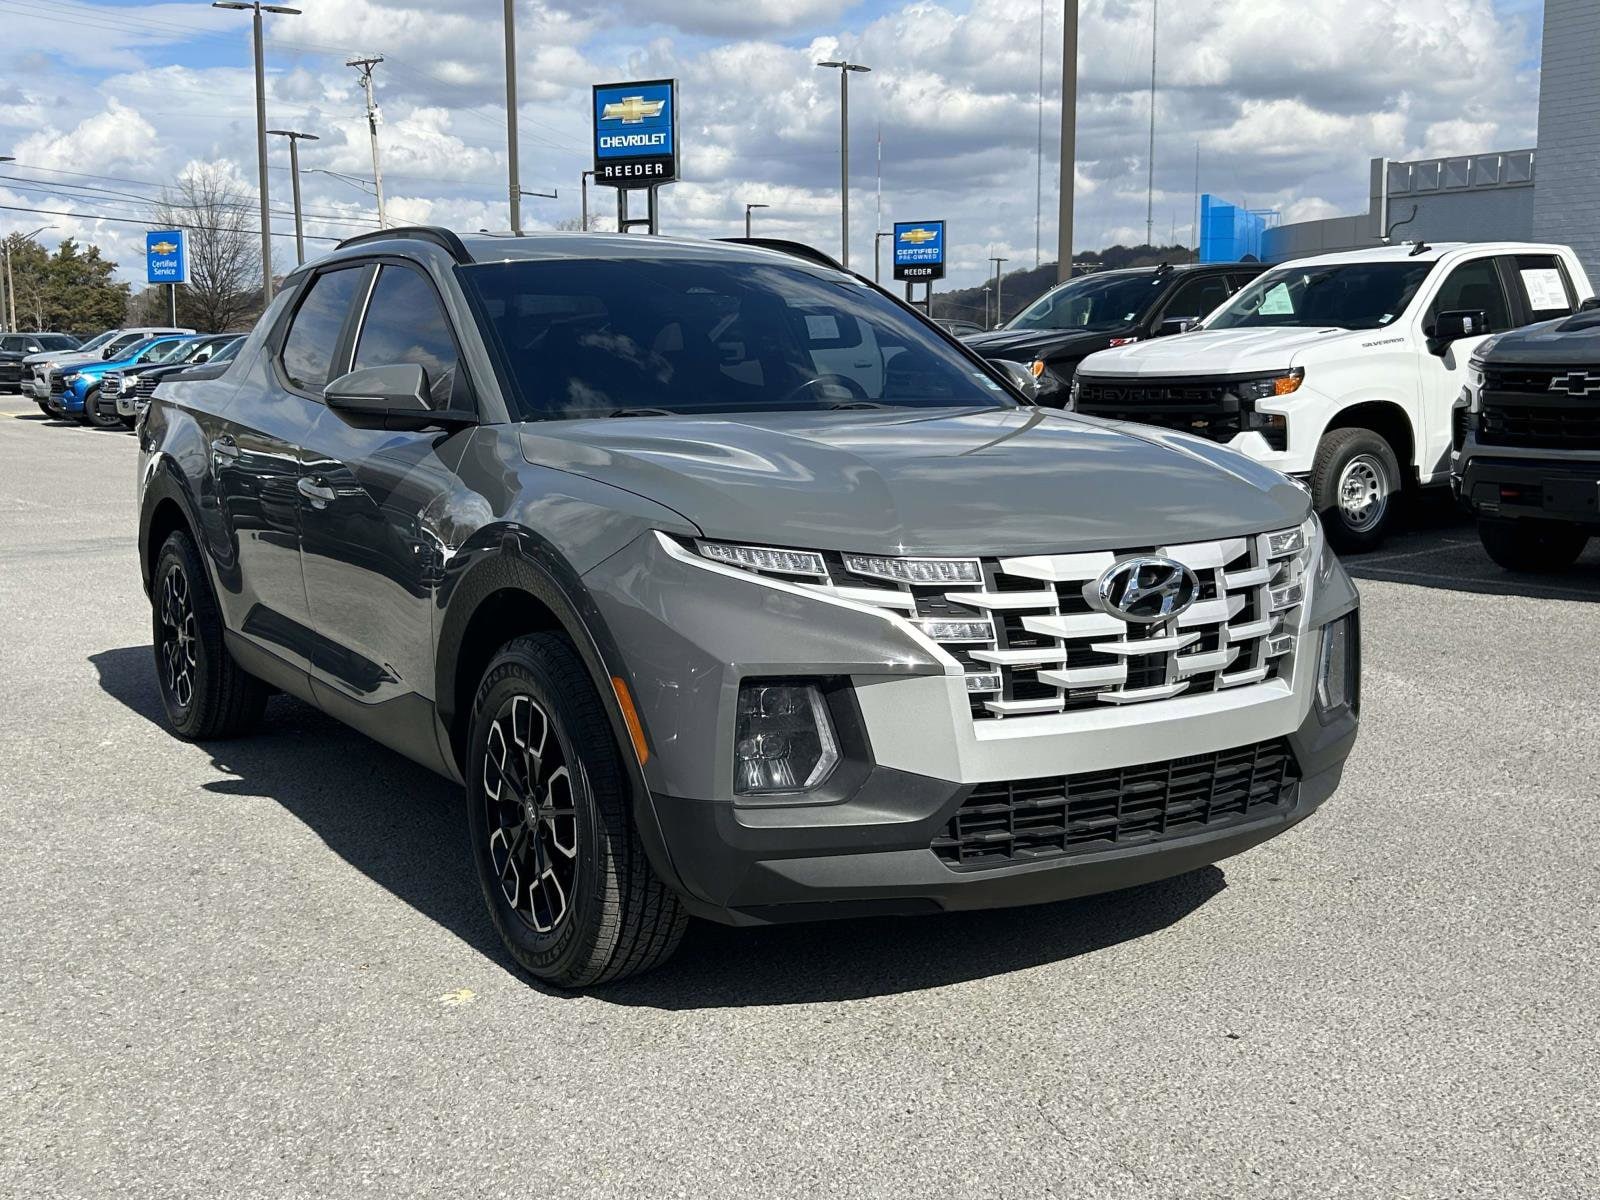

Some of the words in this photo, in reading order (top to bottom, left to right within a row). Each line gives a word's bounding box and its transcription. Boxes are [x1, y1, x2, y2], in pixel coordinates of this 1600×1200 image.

[600, 133, 666, 148] CHEVROLET
[605, 163, 663, 177] REEDER
[152, 260, 177, 268] Certified
[154, 268, 176, 276] Service
[904, 268, 932, 276] REEDER
[1080, 387, 1221, 401] CHEVROLET
